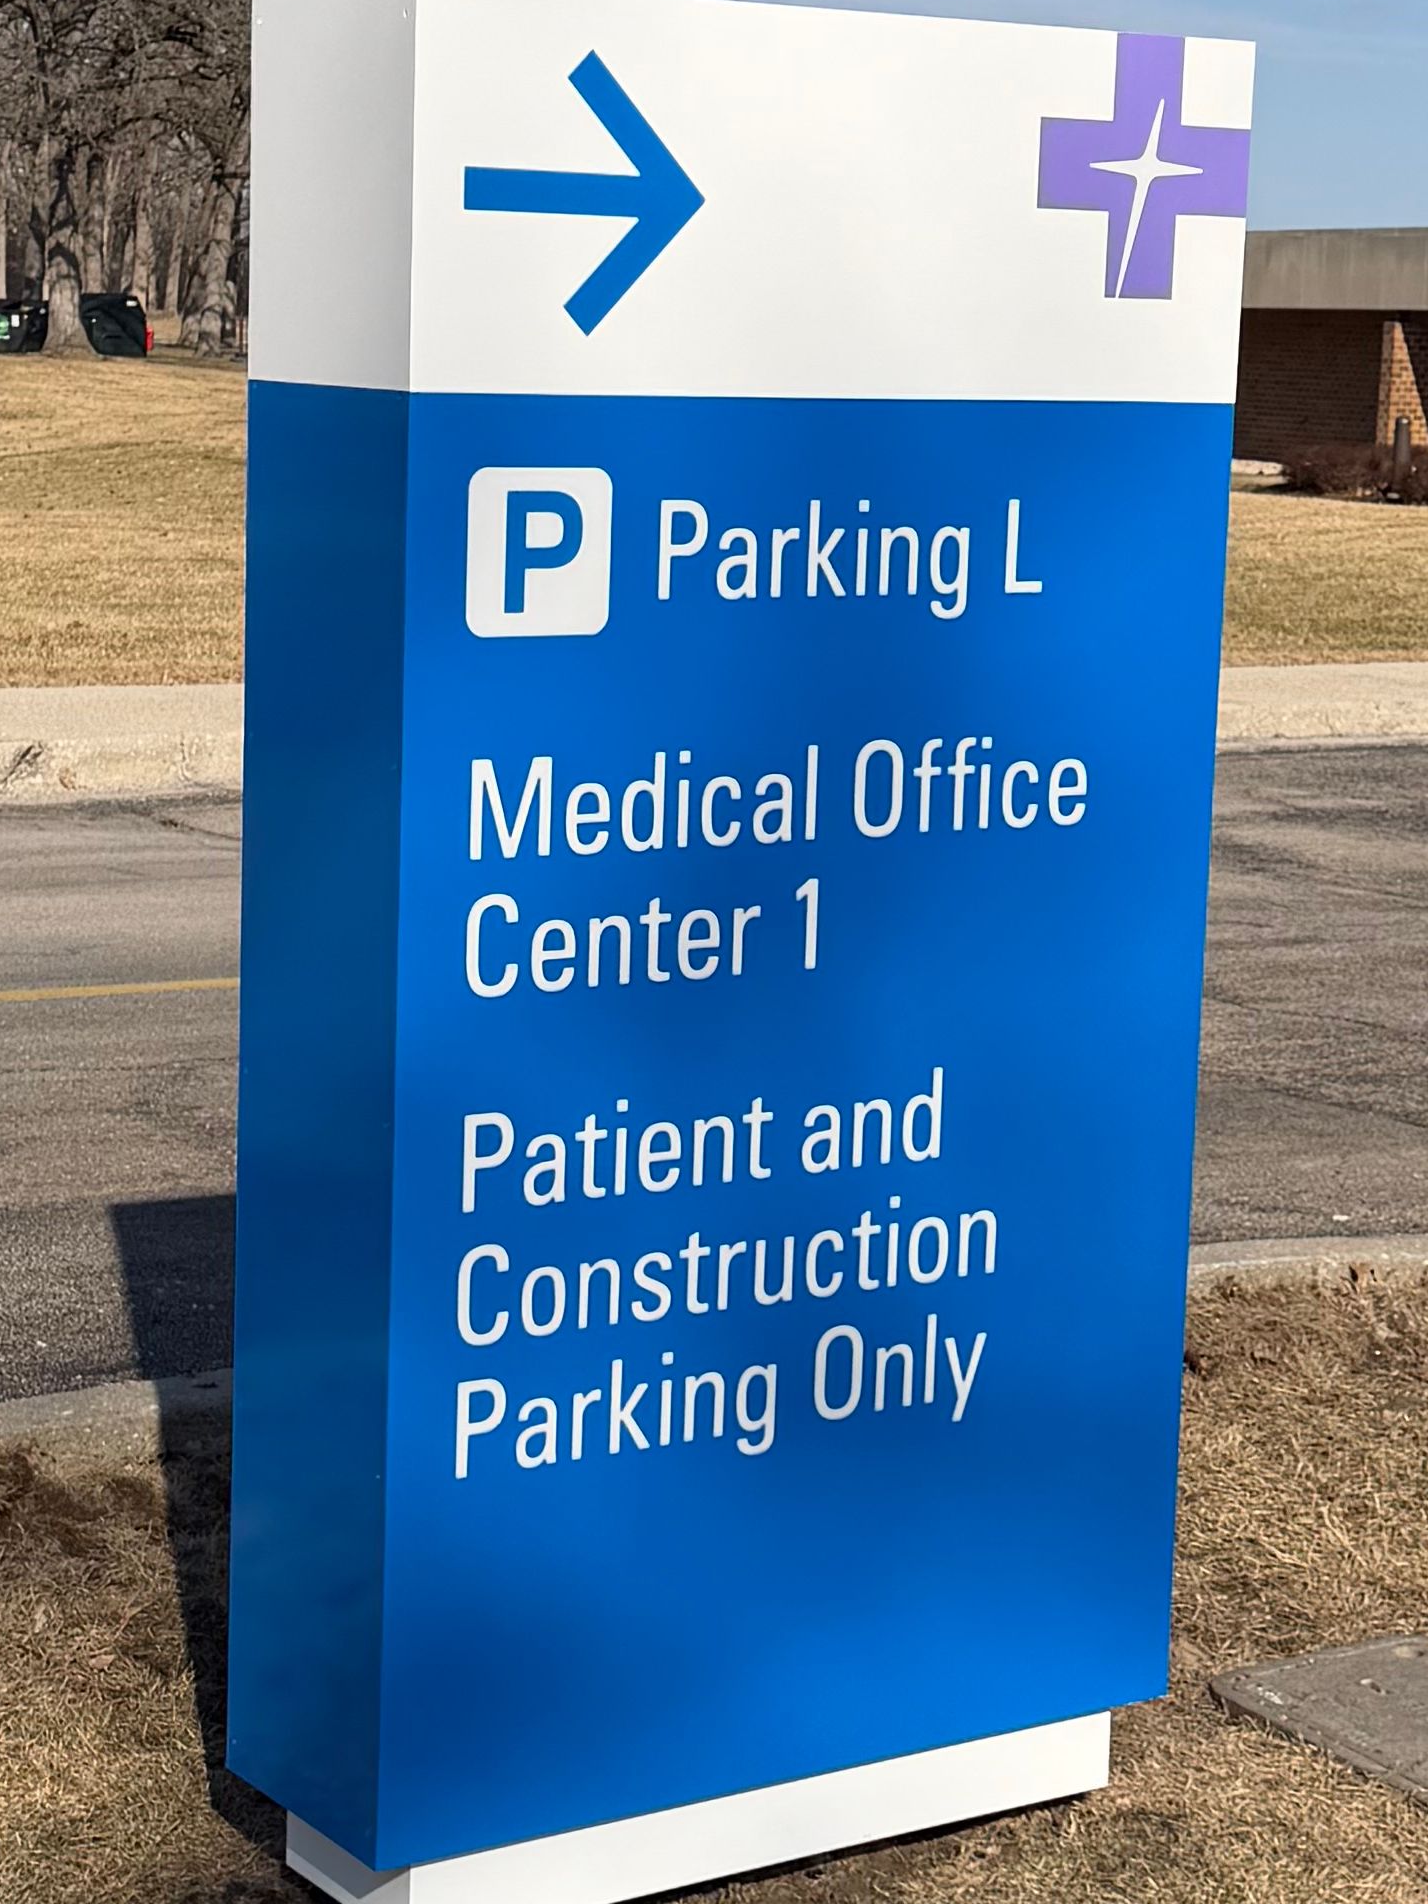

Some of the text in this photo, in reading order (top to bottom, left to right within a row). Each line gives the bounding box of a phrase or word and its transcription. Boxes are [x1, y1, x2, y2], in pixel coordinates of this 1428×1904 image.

[503, 490, 1043, 620] P Parking L
[469, 736, 1088, 861] Medical Office
[465, 878, 819, 998] Center 1
[462, 1066, 944, 1213] Patient and
[457, 1195, 997, 1346] Construction
[455, 1313, 987, 1480] Parking Only
